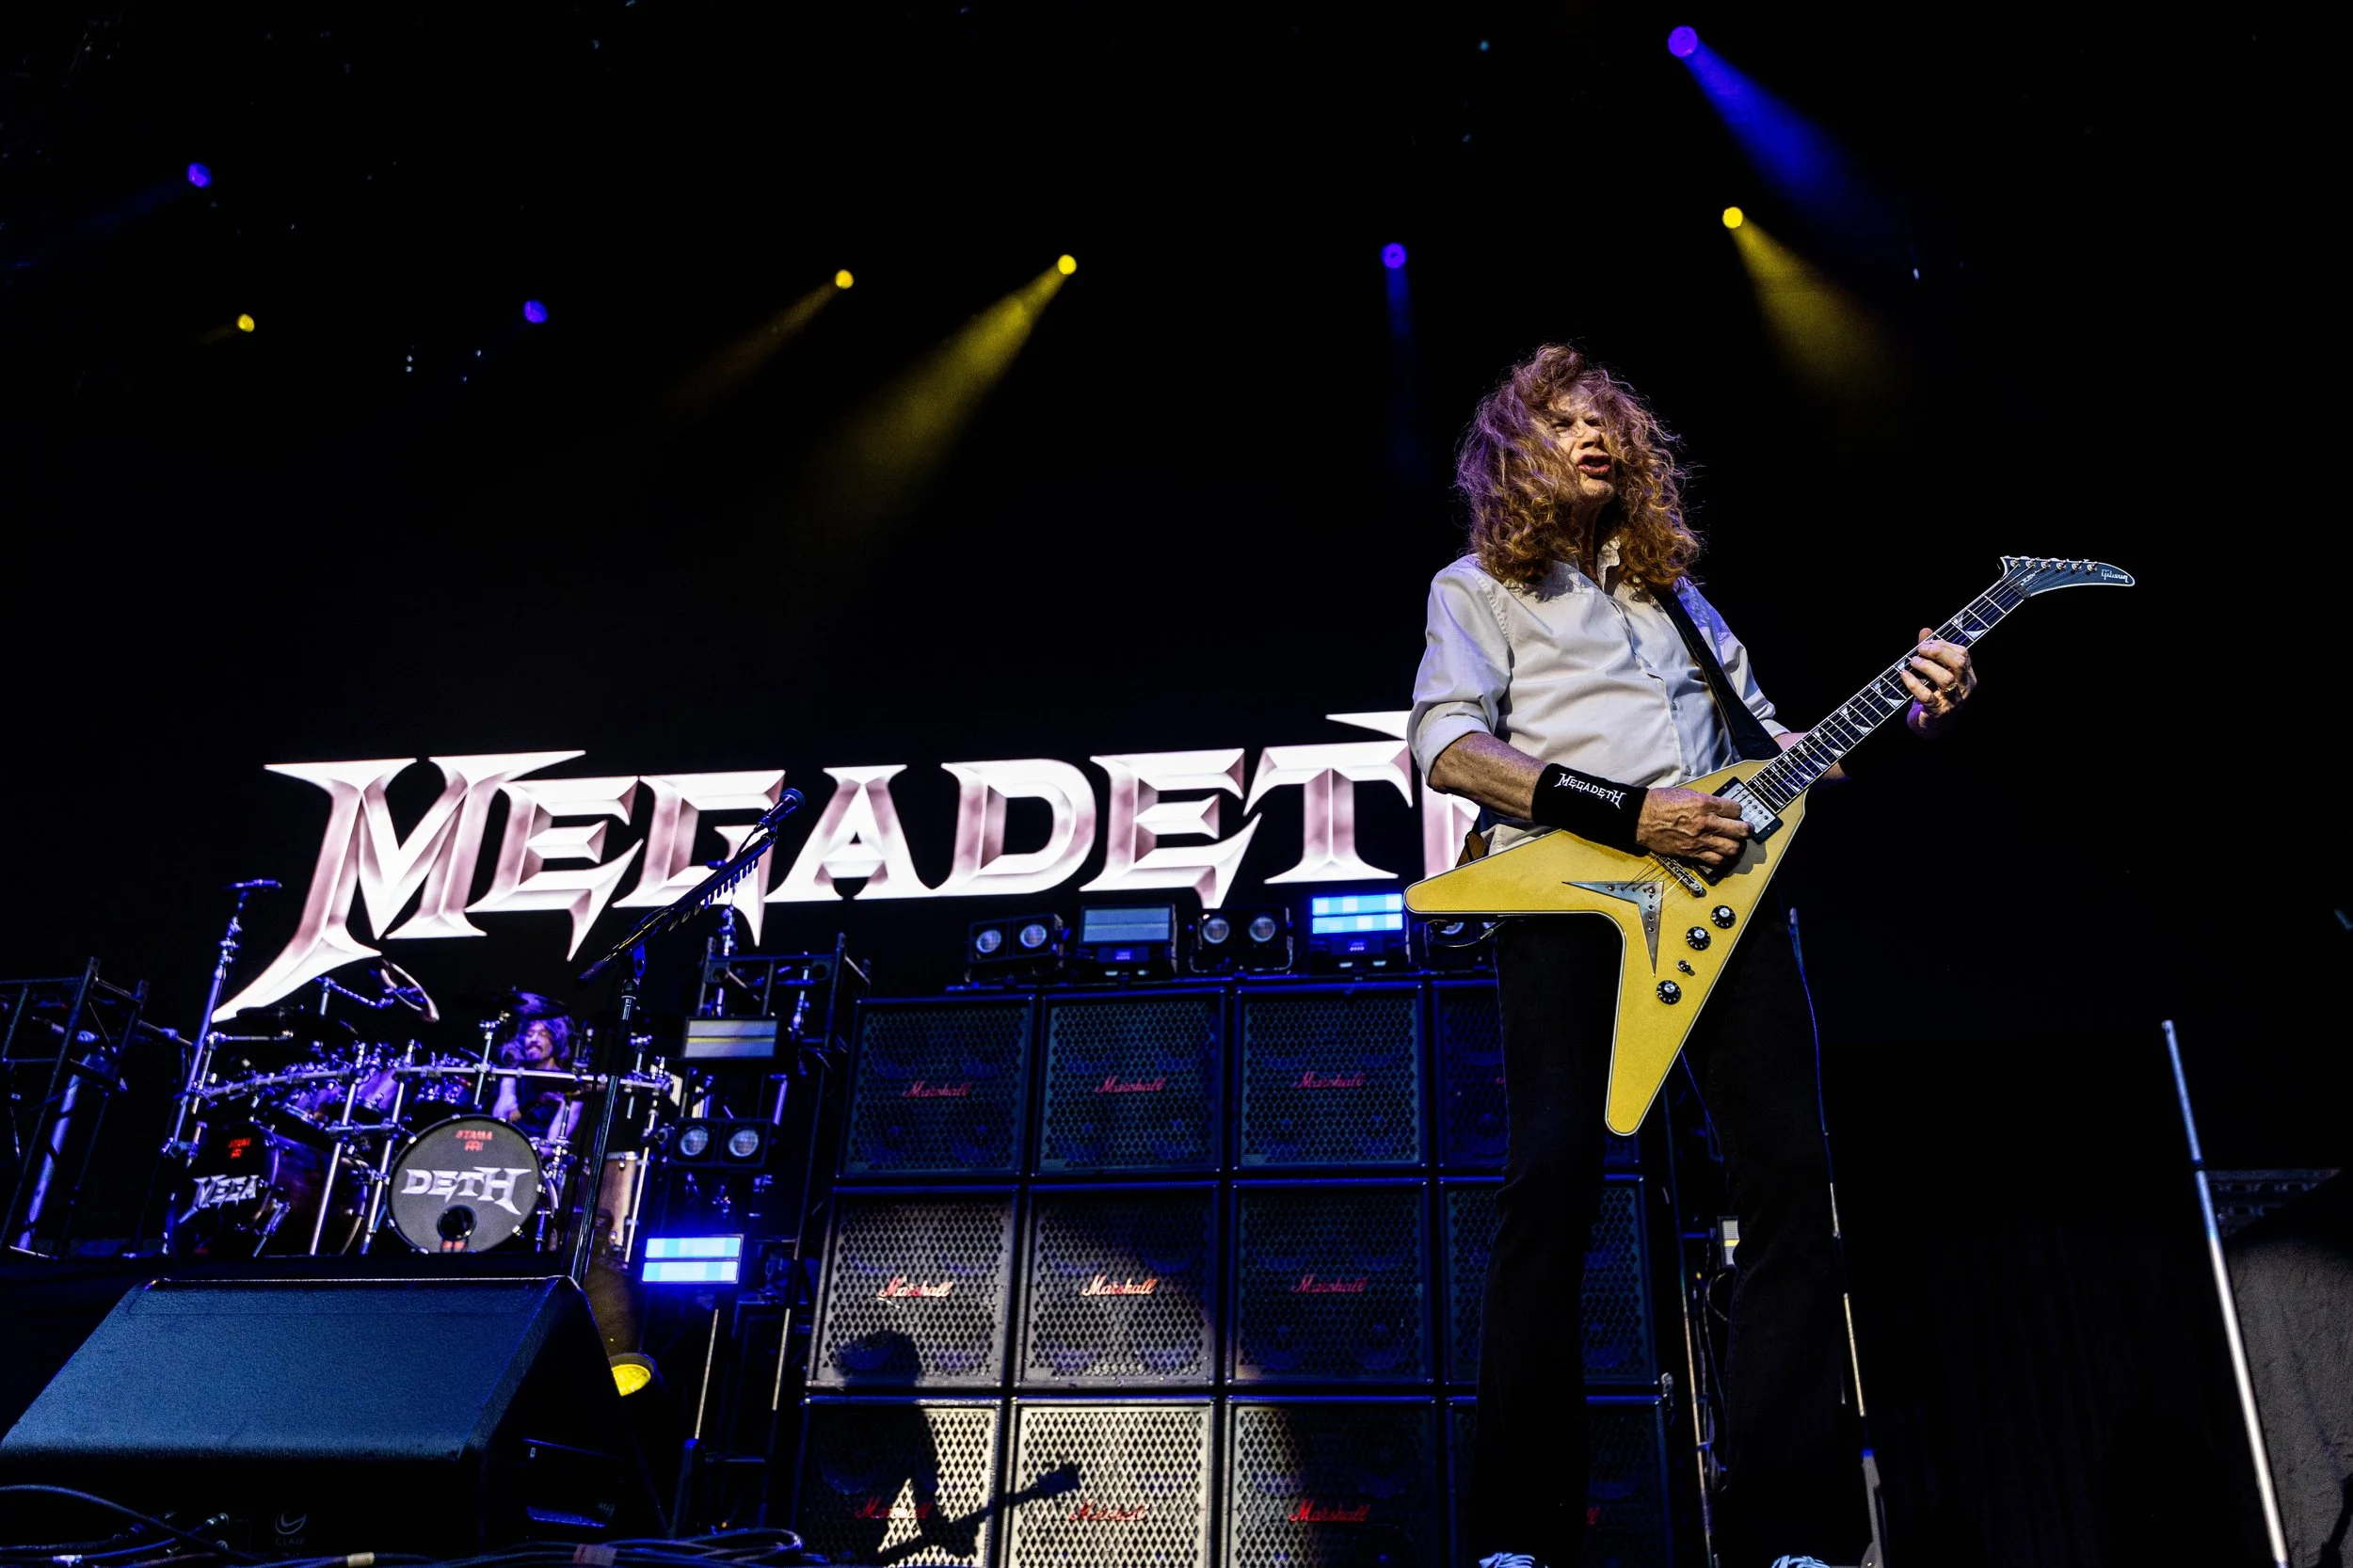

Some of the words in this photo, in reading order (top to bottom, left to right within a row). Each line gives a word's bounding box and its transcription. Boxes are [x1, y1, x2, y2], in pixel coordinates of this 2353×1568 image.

[2101, 568, 2129, 584] Gibson
[1554, 773, 1627, 809] MEGADETH
[212, 710, 1481, 1023] MEGADET
[901, 1079, 973, 1099] Marshall
[1095, 1074, 1168, 1095] Marshall
[1292, 1070, 1369, 1090] Marshall
[400, 1166, 533, 1216] DETH
[877, 1274, 954, 1297] Marshall
[1081, 1273, 1158, 1297] Marshall
[1290, 1272, 1370, 1294] Marshall
[1288, 1495, 1371, 1523] Marshall
